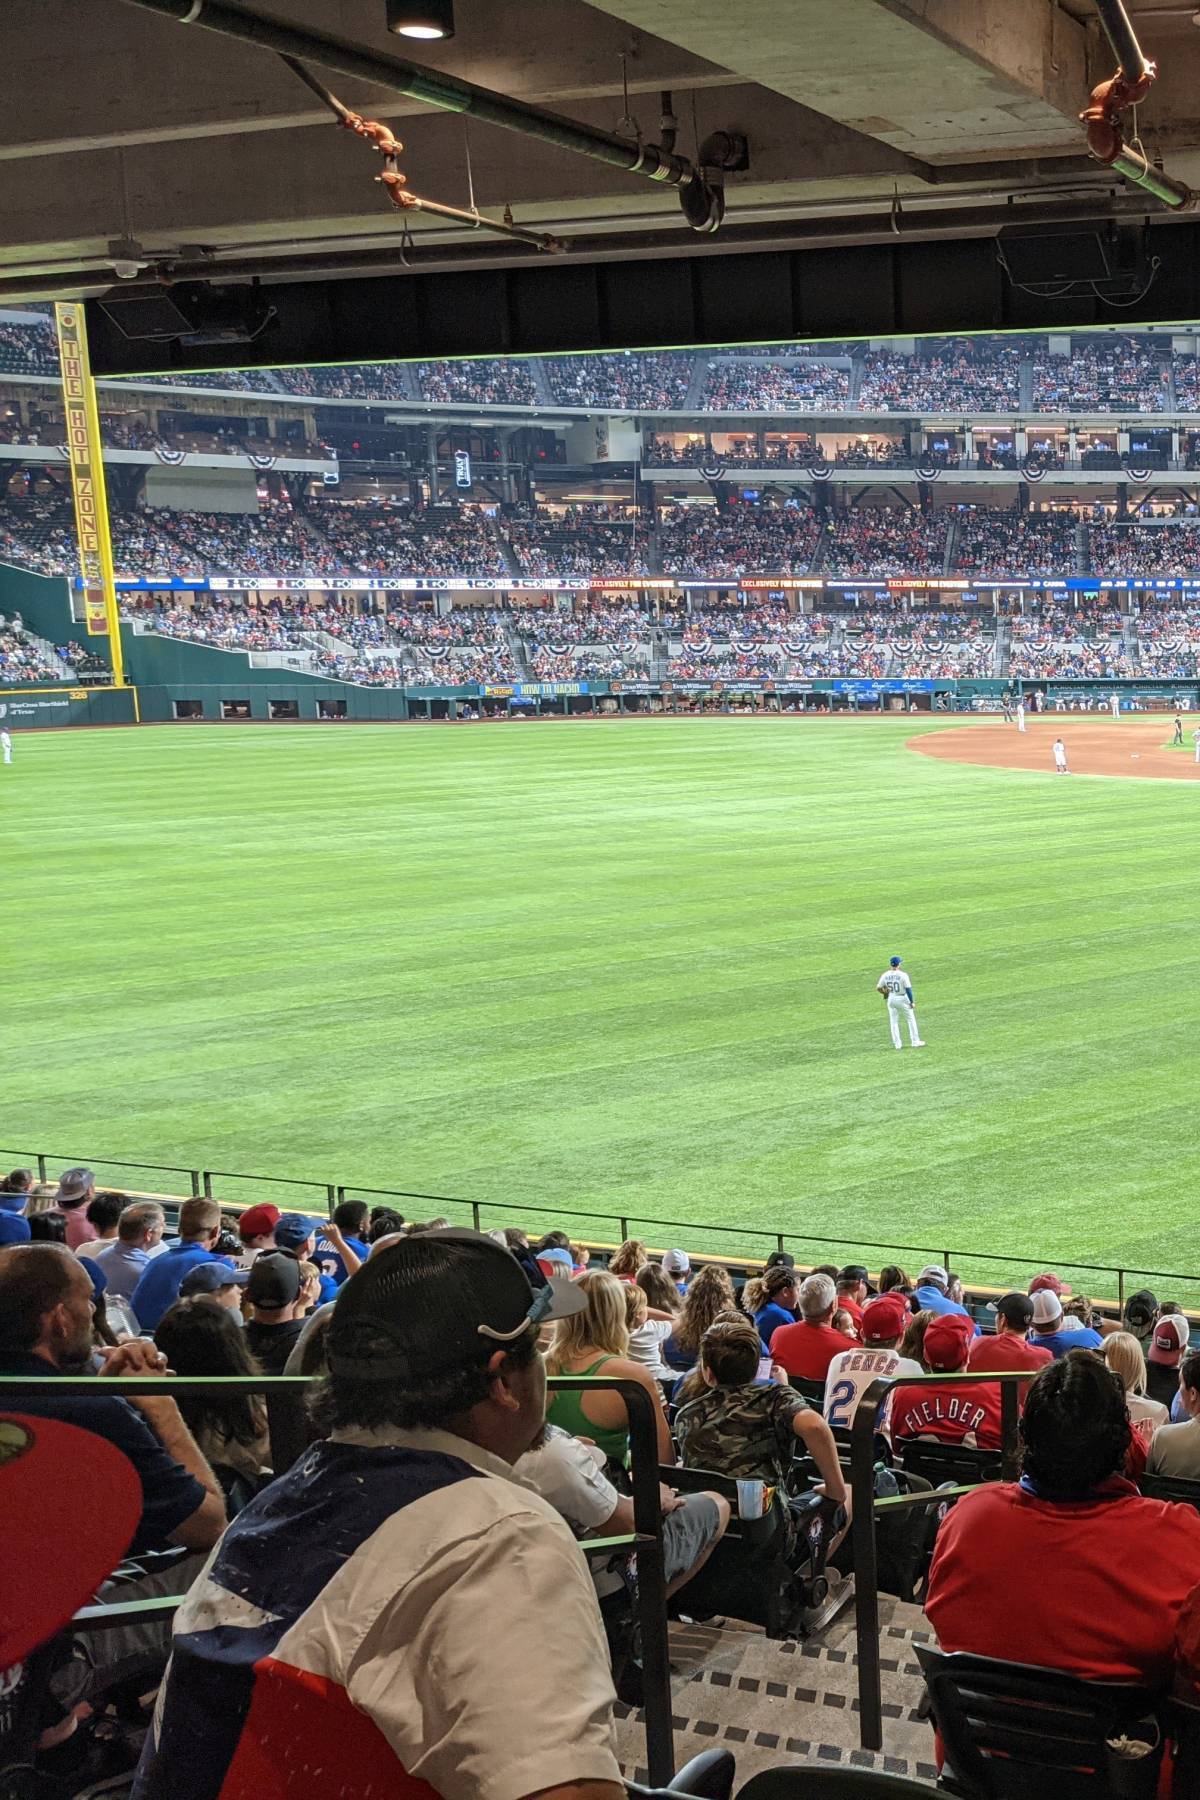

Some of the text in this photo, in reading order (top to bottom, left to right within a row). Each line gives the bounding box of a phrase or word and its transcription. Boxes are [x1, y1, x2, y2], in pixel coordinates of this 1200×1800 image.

[65, 342, 81, 395] THE
[72, 411, 88, 463] HOT
[79, 480, 97, 549] ZONE
[69, 691, 88, 700] 326
[886, 981, 900, 993] 50
[839, 1352, 899, 1376] PENCE
[905, 1398, 986, 1433] FIELDER
